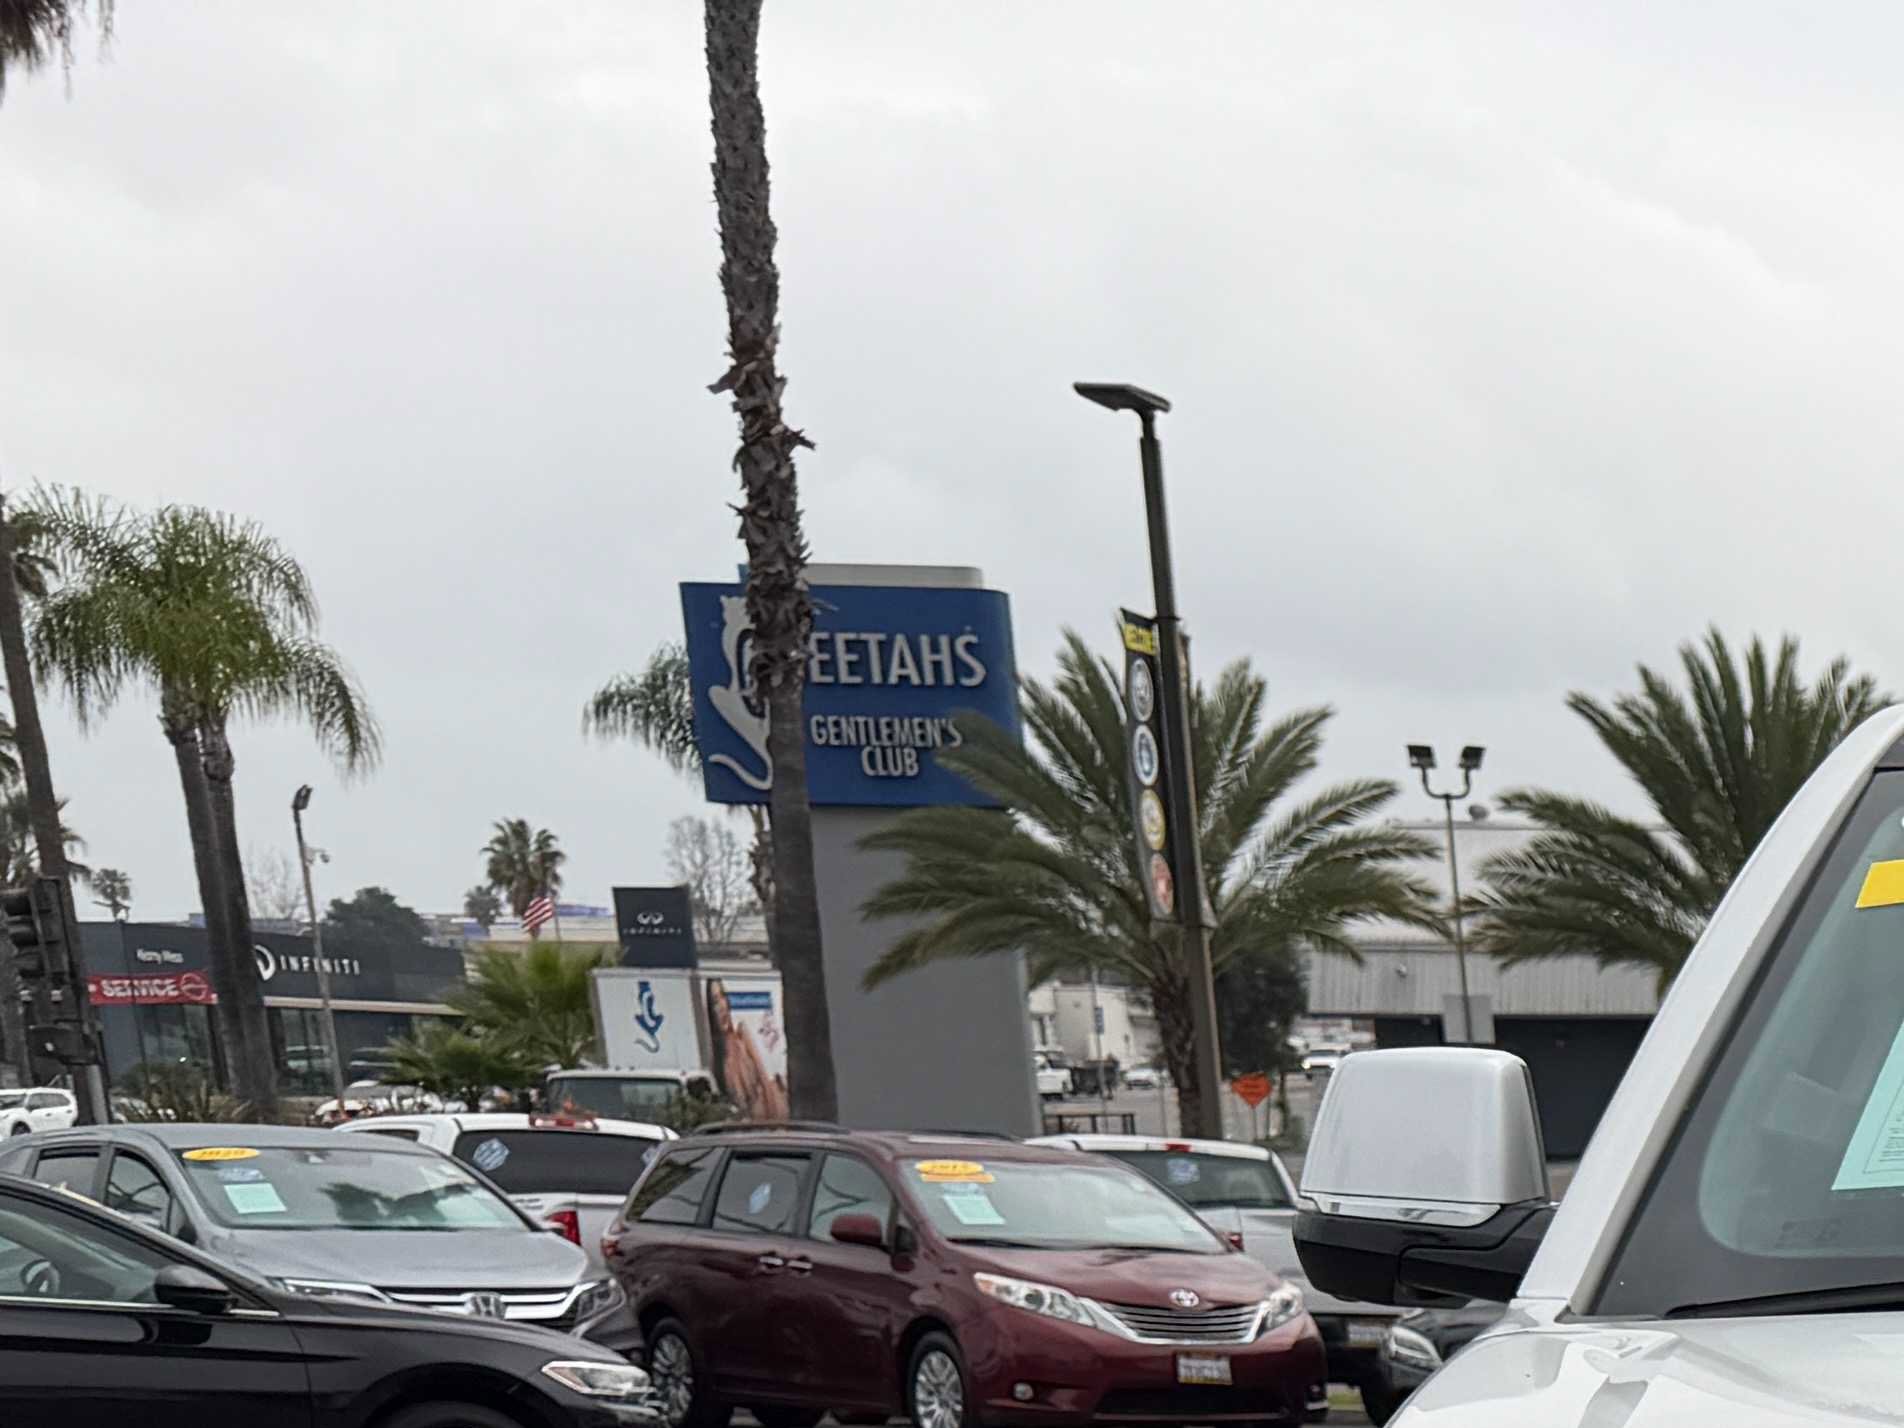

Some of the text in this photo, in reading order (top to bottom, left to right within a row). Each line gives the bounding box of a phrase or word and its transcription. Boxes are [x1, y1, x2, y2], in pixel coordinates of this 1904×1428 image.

[809, 632, 987, 688] EETAHS
[810, 714, 962, 748] GENTLEMEN'S
[860, 746, 920, 777] CLUB
[280, 954, 360, 976] INFINITI
[101, 978, 179, 997] SERVICE
